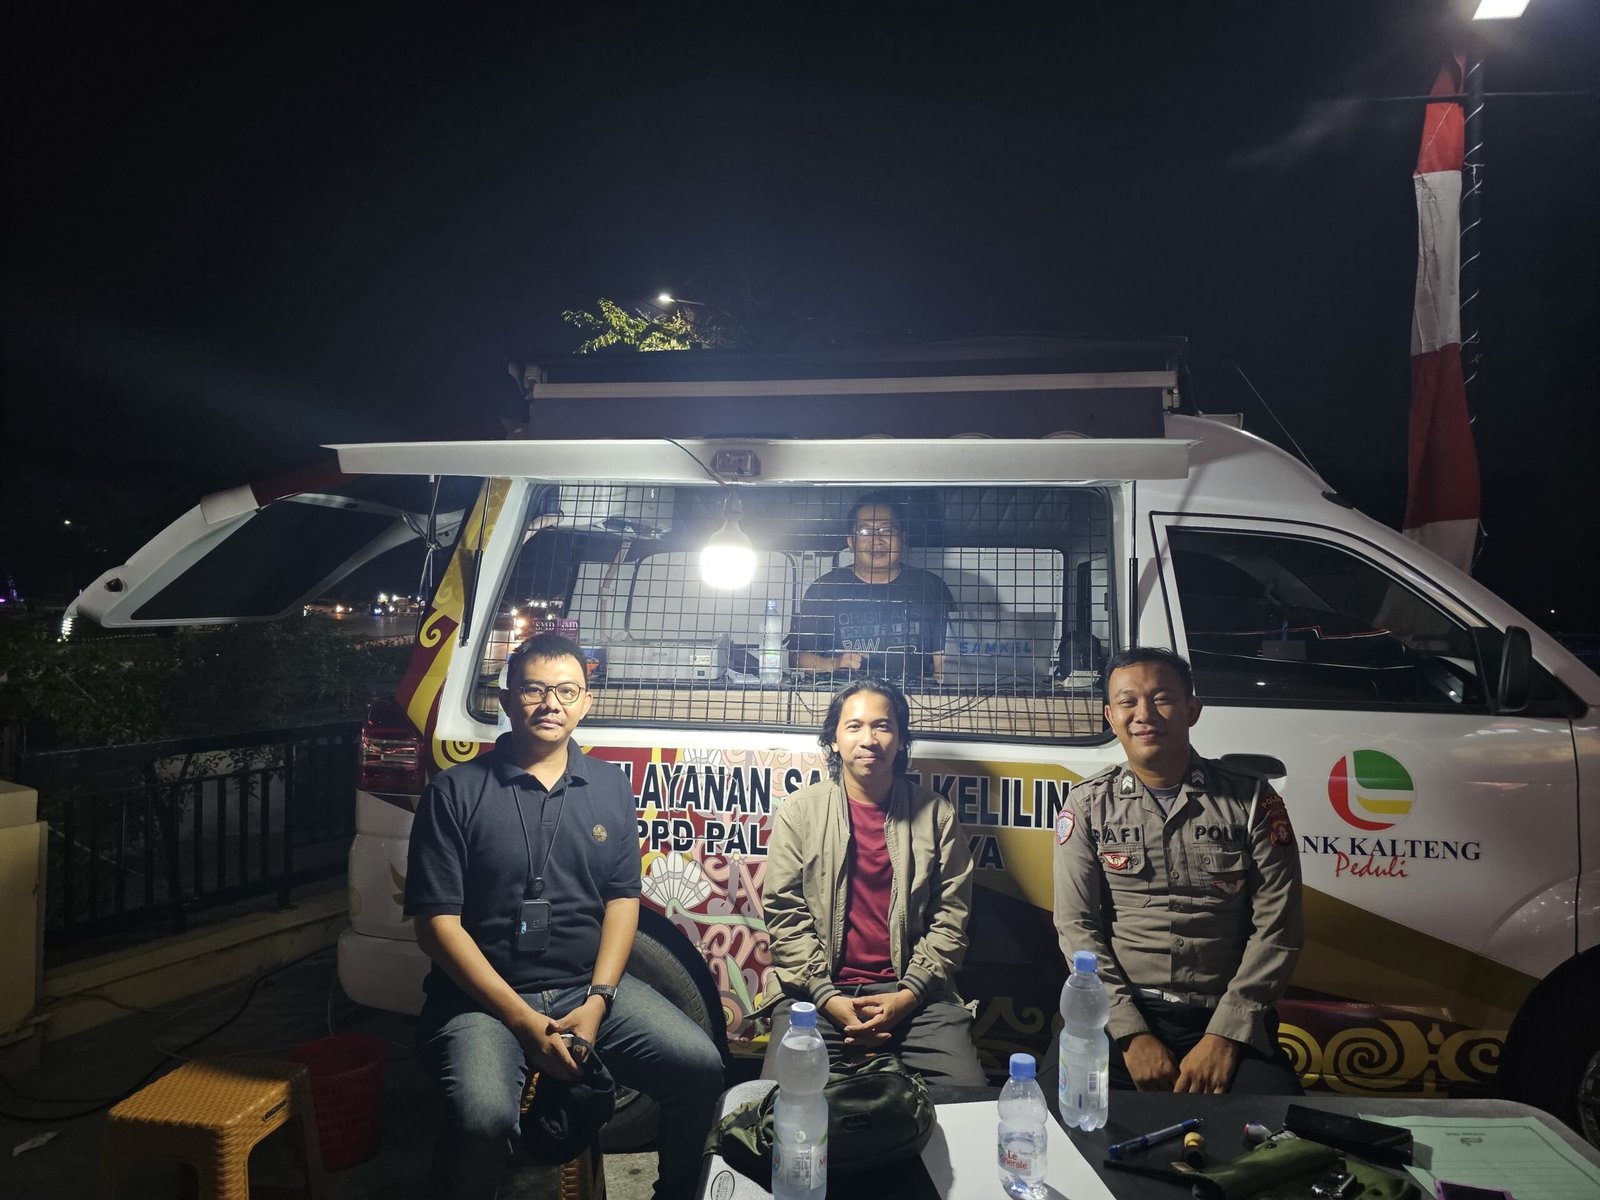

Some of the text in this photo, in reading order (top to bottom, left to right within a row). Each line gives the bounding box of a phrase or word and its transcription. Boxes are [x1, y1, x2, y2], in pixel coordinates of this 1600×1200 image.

[614, 762, 772, 814] AYANAN
[931, 774, 1071, 830] KELILIN
[637, 819, 1006, 871] PPD PAL YA
[1092, 826, 1140, 844] RAFI
[1195, 824, 1246, 843] POLR
[1297, 835, 1481, 861] NK KALTENG
[1336, 850, 1408, 878] Peduli
